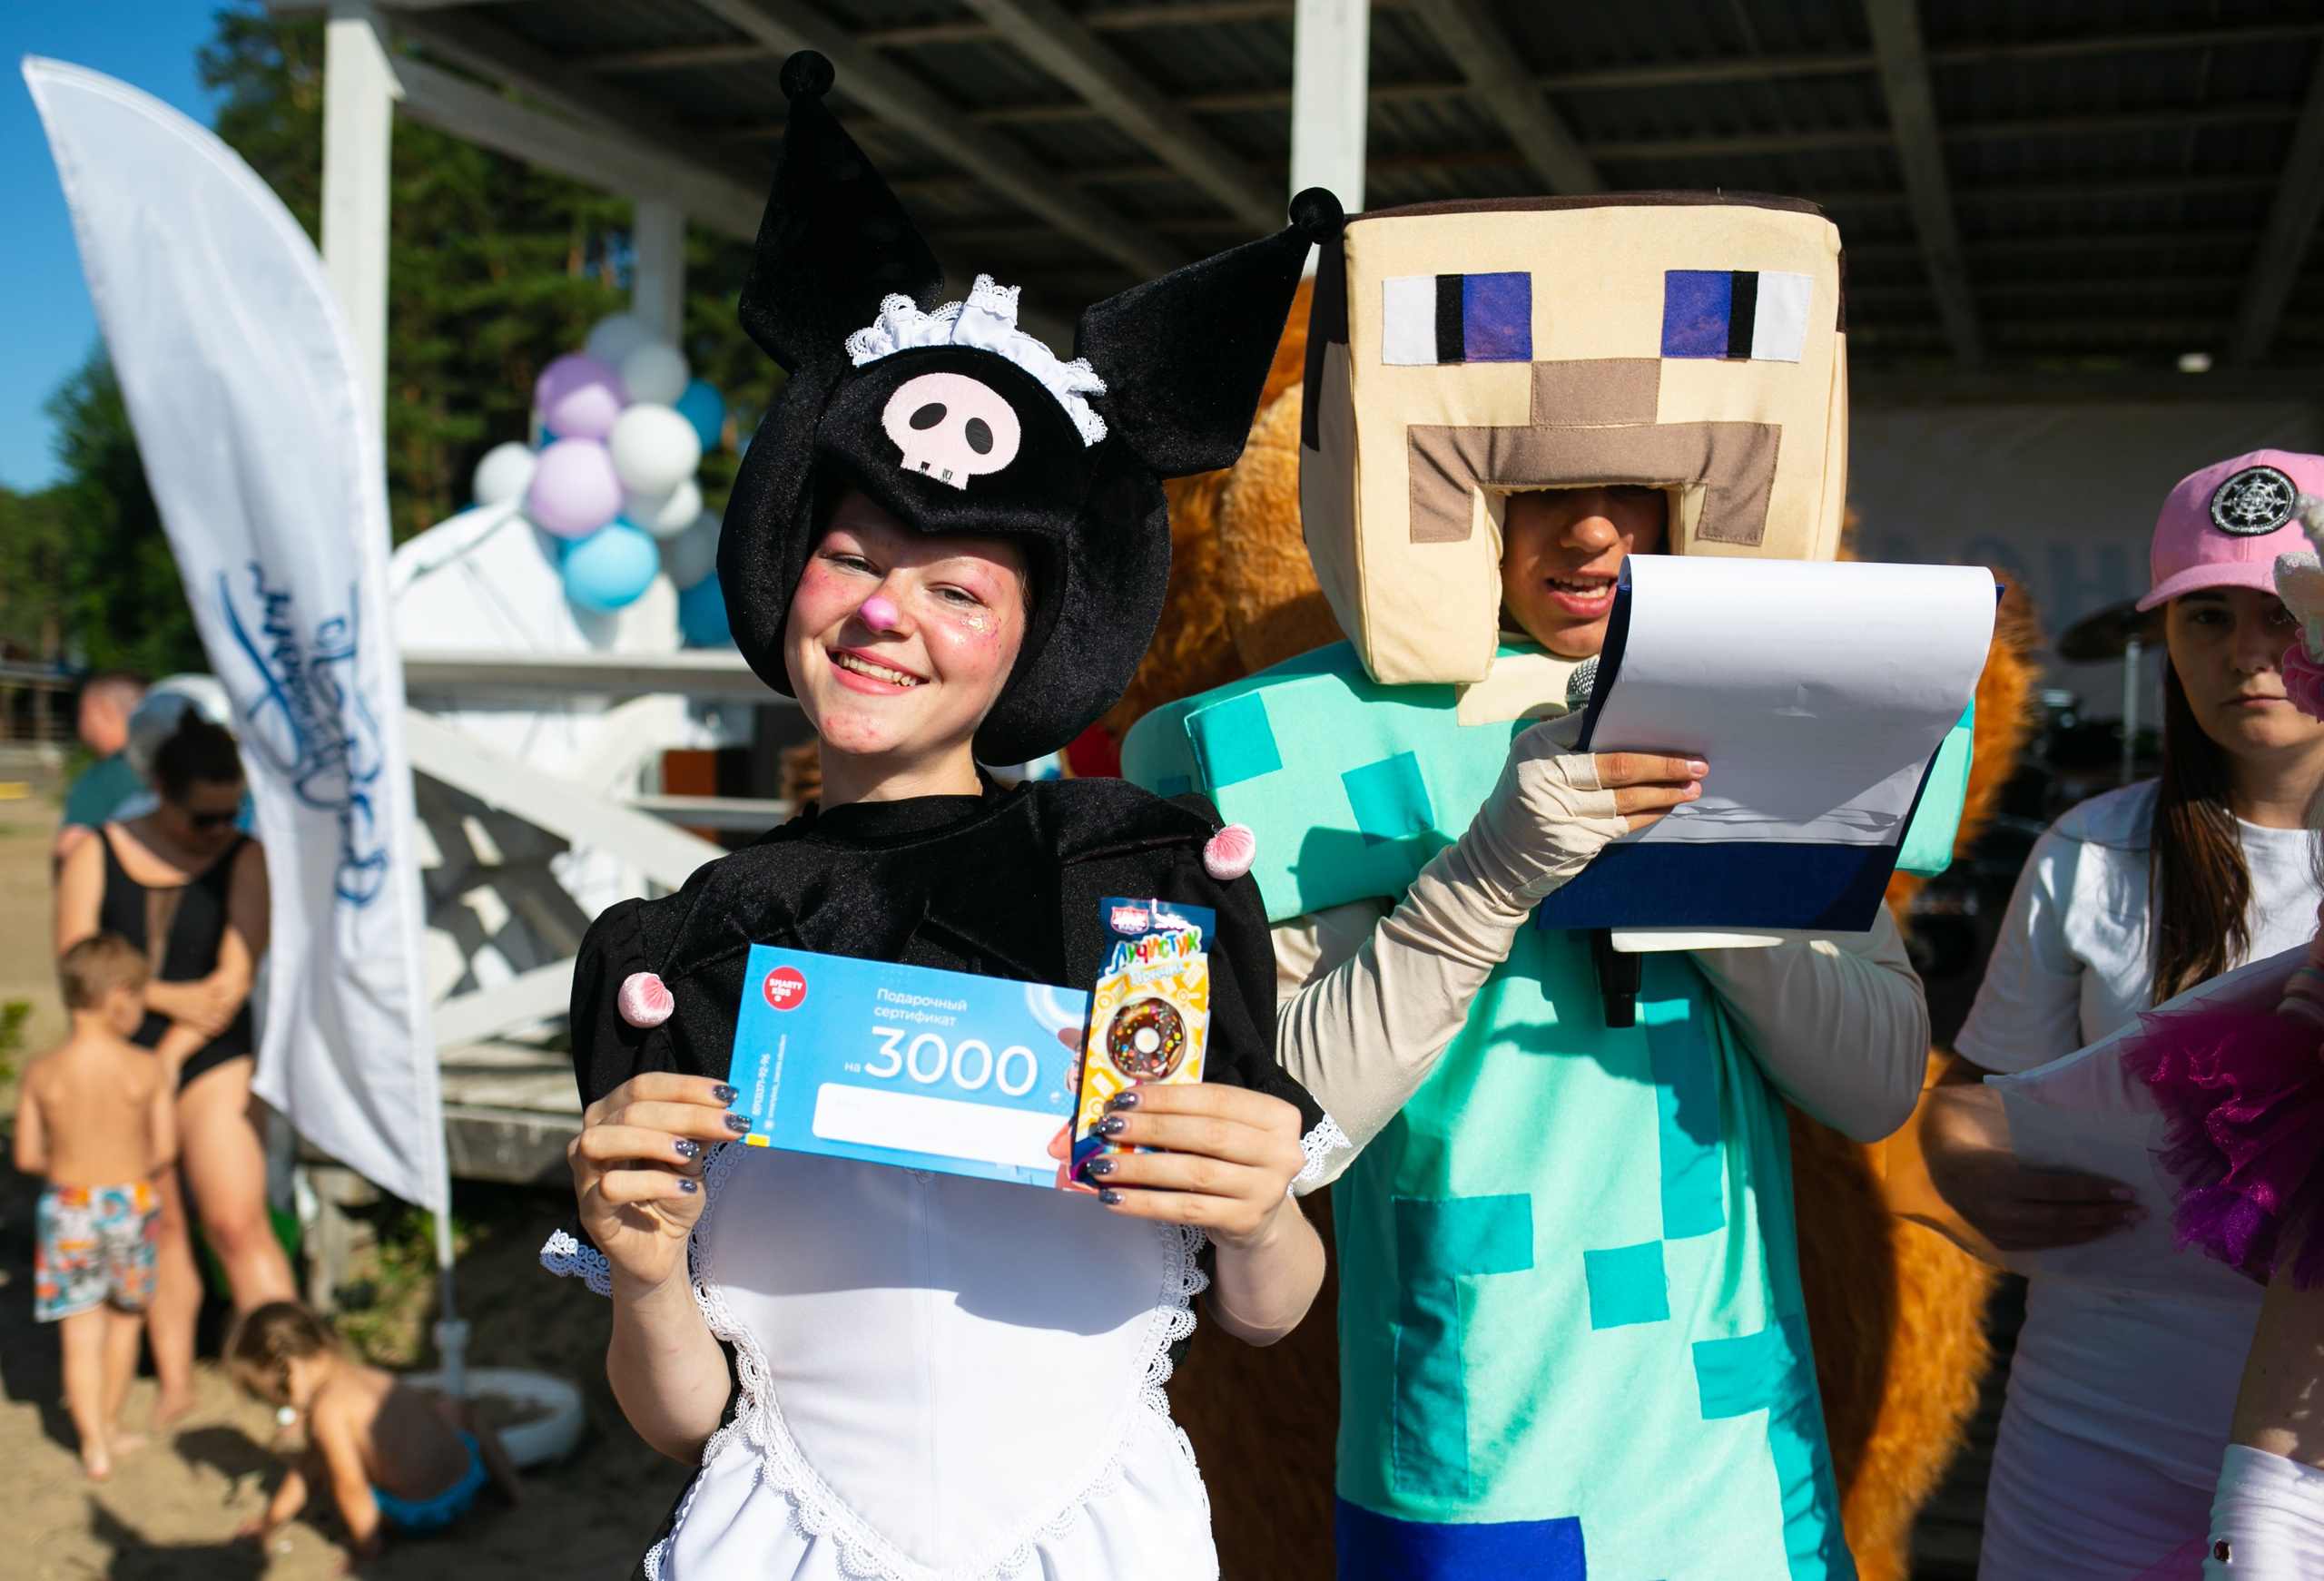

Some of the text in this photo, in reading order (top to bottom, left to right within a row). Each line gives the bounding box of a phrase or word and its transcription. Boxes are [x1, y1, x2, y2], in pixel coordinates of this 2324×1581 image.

[769, 978, 803, 990] SMARTY
[877, 988, 968, 1012] Подарочный
[874, 1007, 958, 1026] сертификат
[844, 1025, 1039, 1096] на 3000
